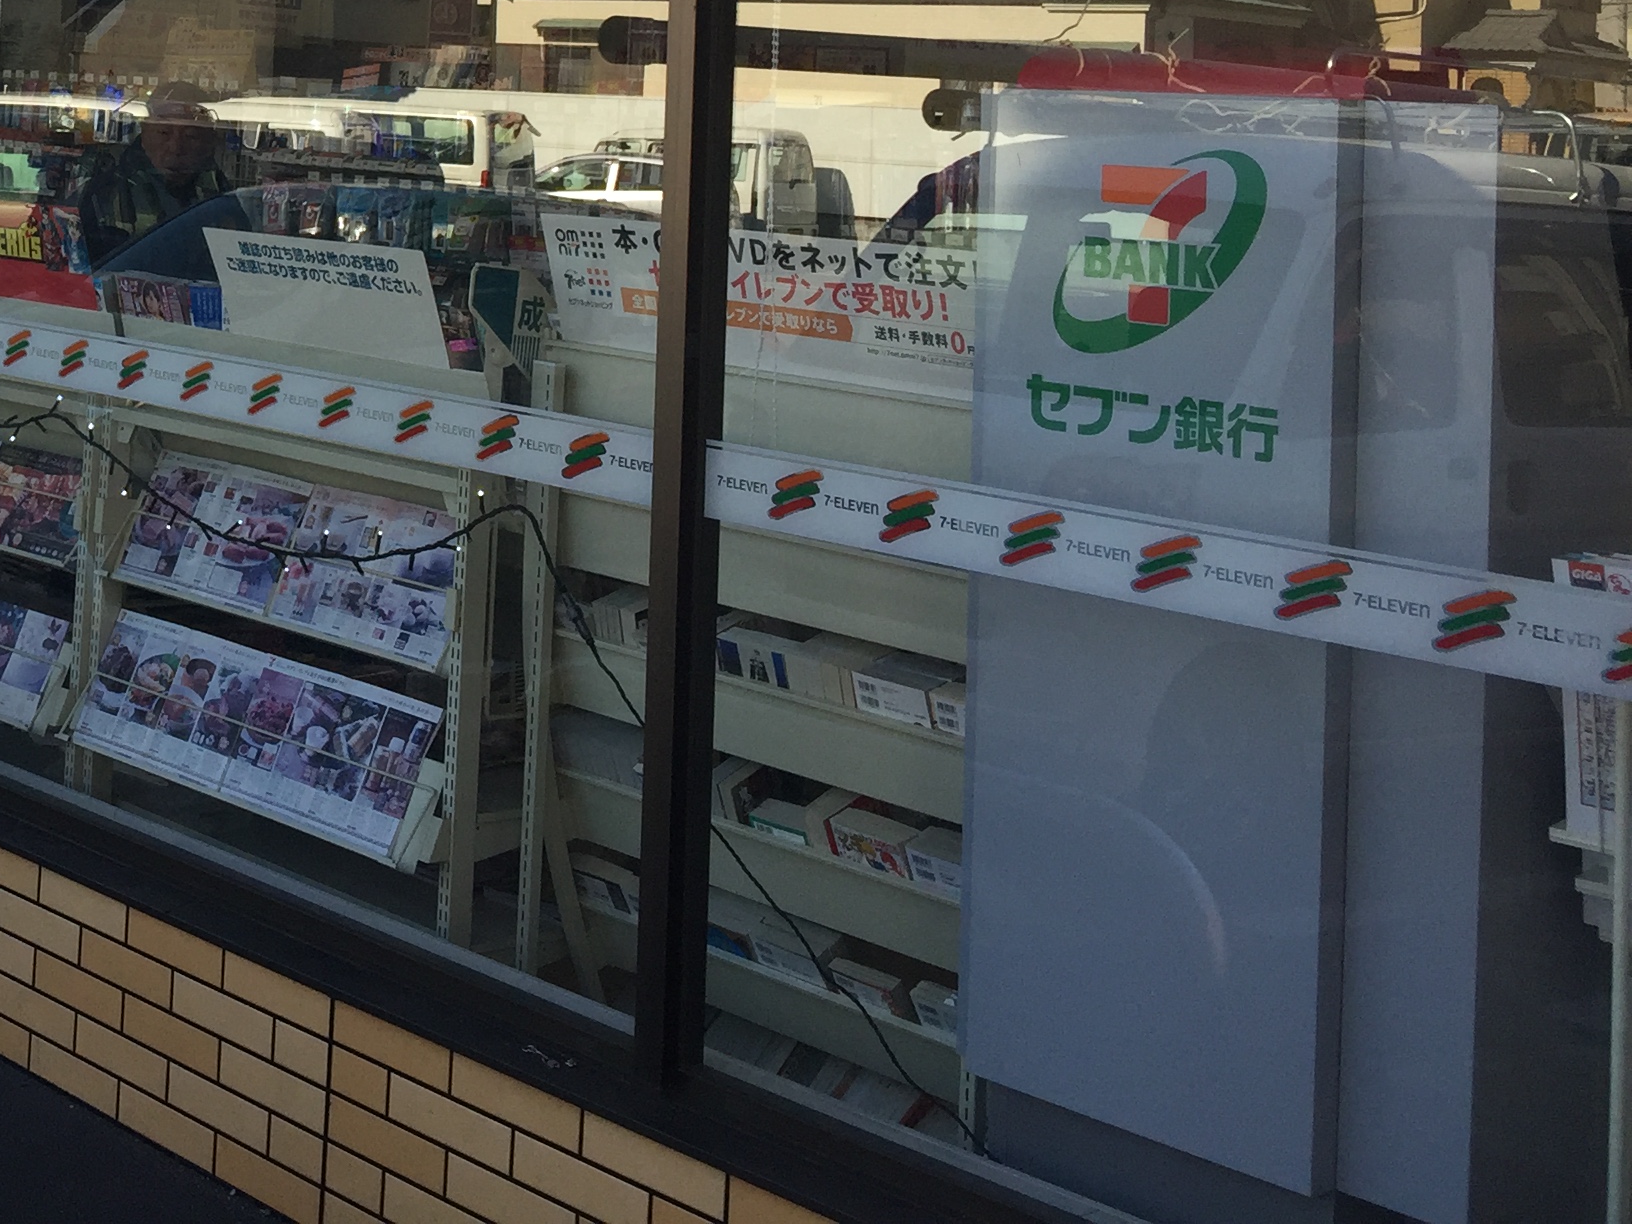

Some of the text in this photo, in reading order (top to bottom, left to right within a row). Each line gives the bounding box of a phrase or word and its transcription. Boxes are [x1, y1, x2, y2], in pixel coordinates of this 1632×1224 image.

[225, 256, 424, 297] ご迷惑になりますので、ご遠慮ください。
[237, 240, 399, 274] 雑誌の立ち読みは他のお客様の
[1081, 237, 1223, 290] BANK
[517, 295, 546, 333] 成
[1024, 372, 1280, 464] セブン銀行
